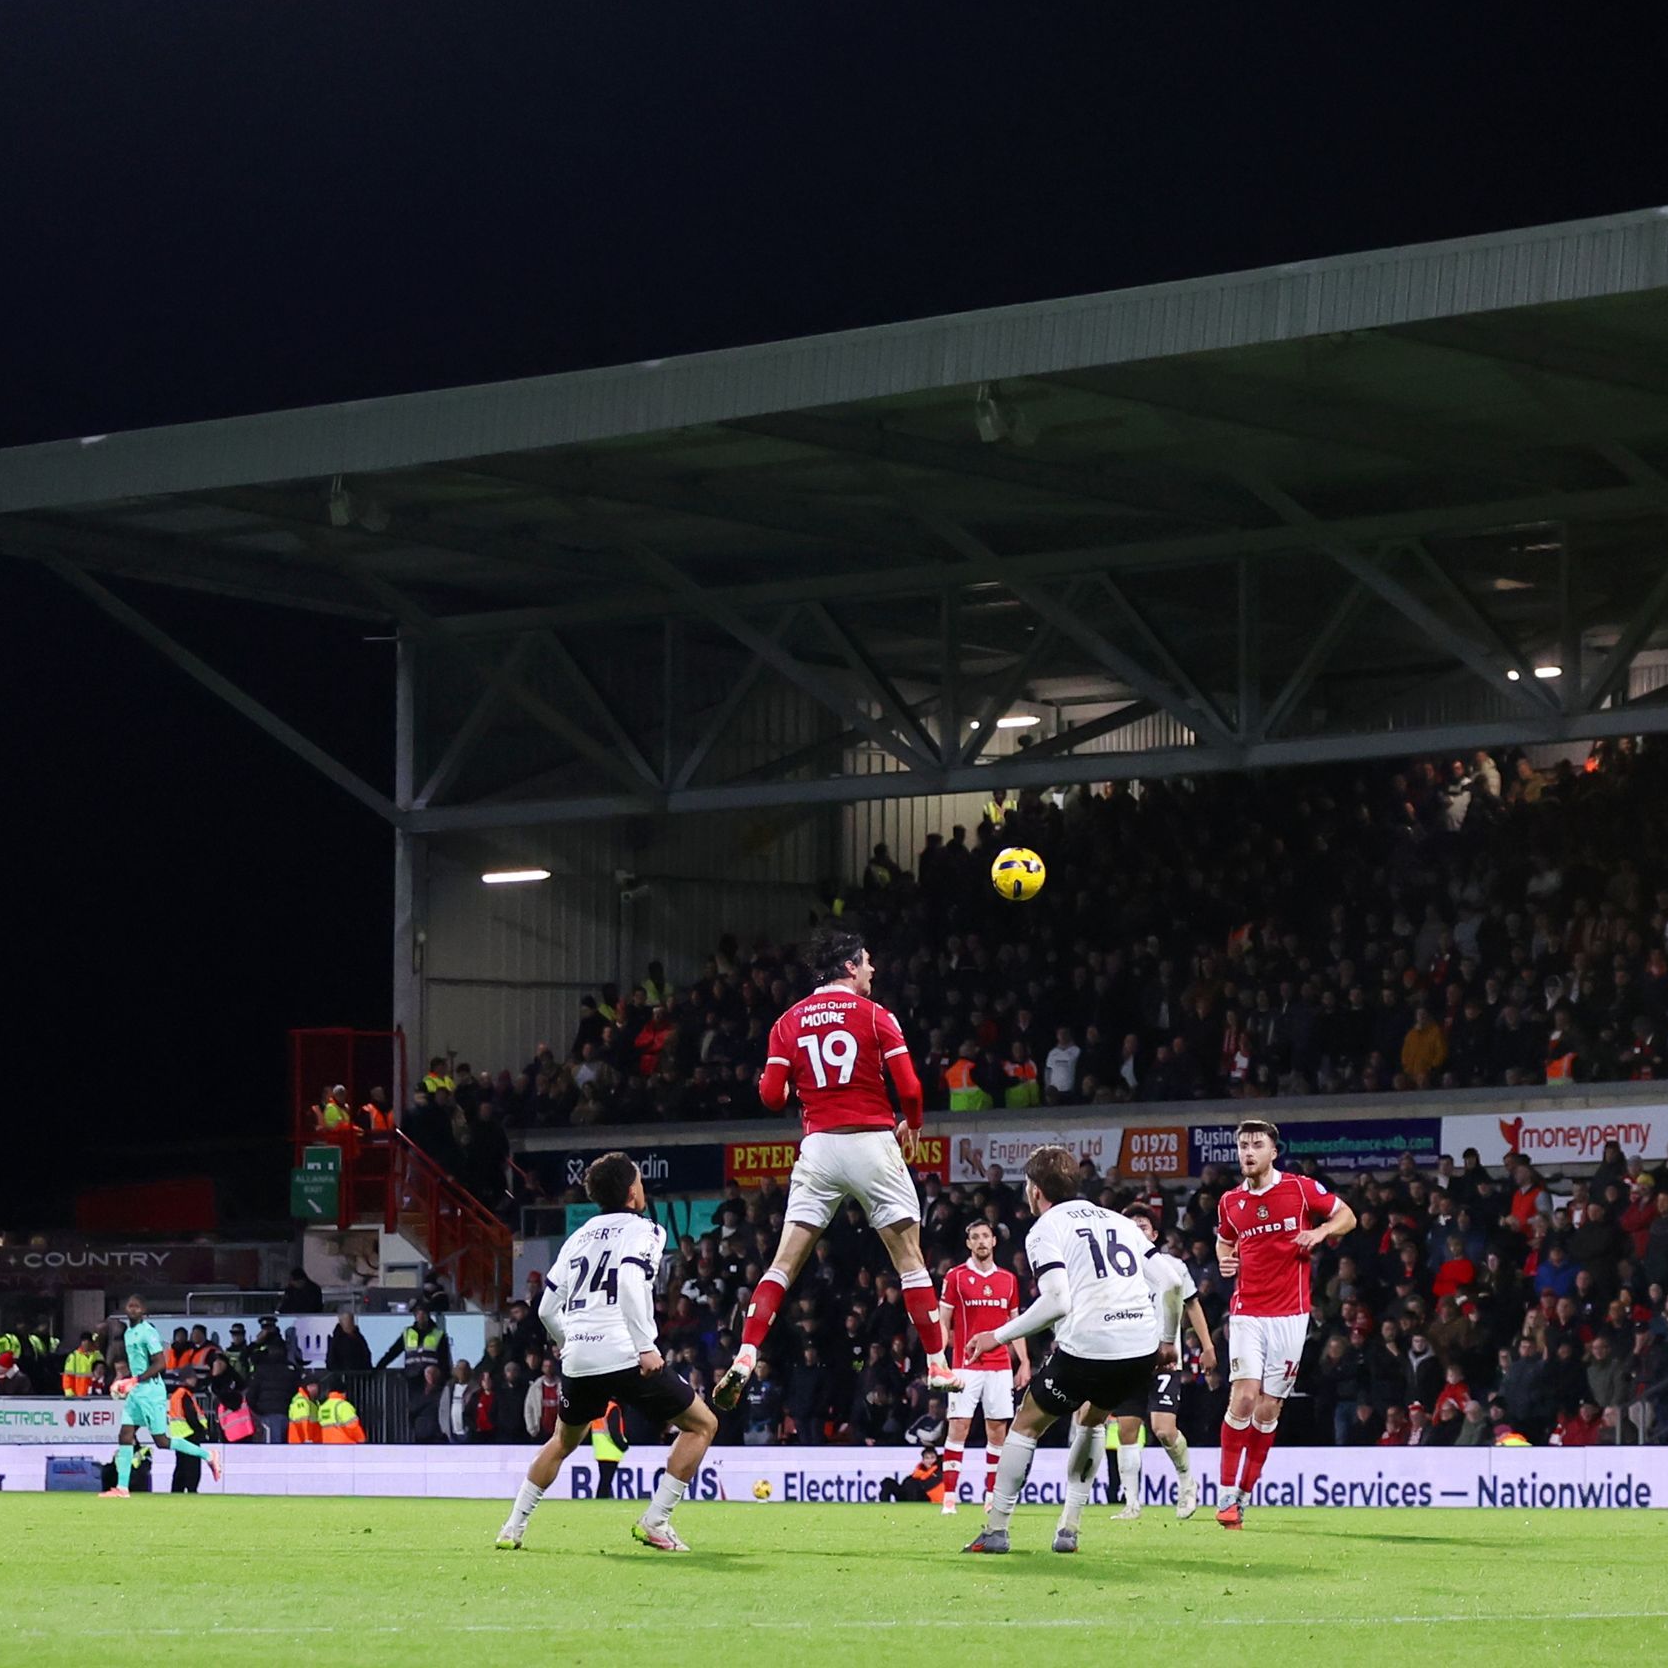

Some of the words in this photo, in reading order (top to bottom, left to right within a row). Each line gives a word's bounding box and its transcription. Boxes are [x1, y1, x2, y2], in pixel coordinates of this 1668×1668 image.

[804, 1002, 827, 1014] Meta
[828, 1001, 858, 1012] Quest
[801, 1012, 846, 1028] MOORE
[797, 1030, 858, 1088] 19
[1132, 1134, 1178, 1154] 01978
[1522, 1123, 1651, 1155] moneypenny
[733, 1146, 795, 1170] PETER
[1131, 1155, 1178, 1172] 661523
[1240, 1222, 1282, 1240] UNITED
[24, 1251, 170, 1268] COUNTRY
[1076, 1228, 1138, 1279] 16
[568, 1250, 619, 1312] 24
[965, 1299, 1000, 1307] UNITED
[1104, 1308, 1144, 1322] GoSkippy
[1157, 1374, 1172, 1393] 7
[1313, 1472, 1432, 1507] Services
[1478, 1472, 1651, 1508] Nationwide
